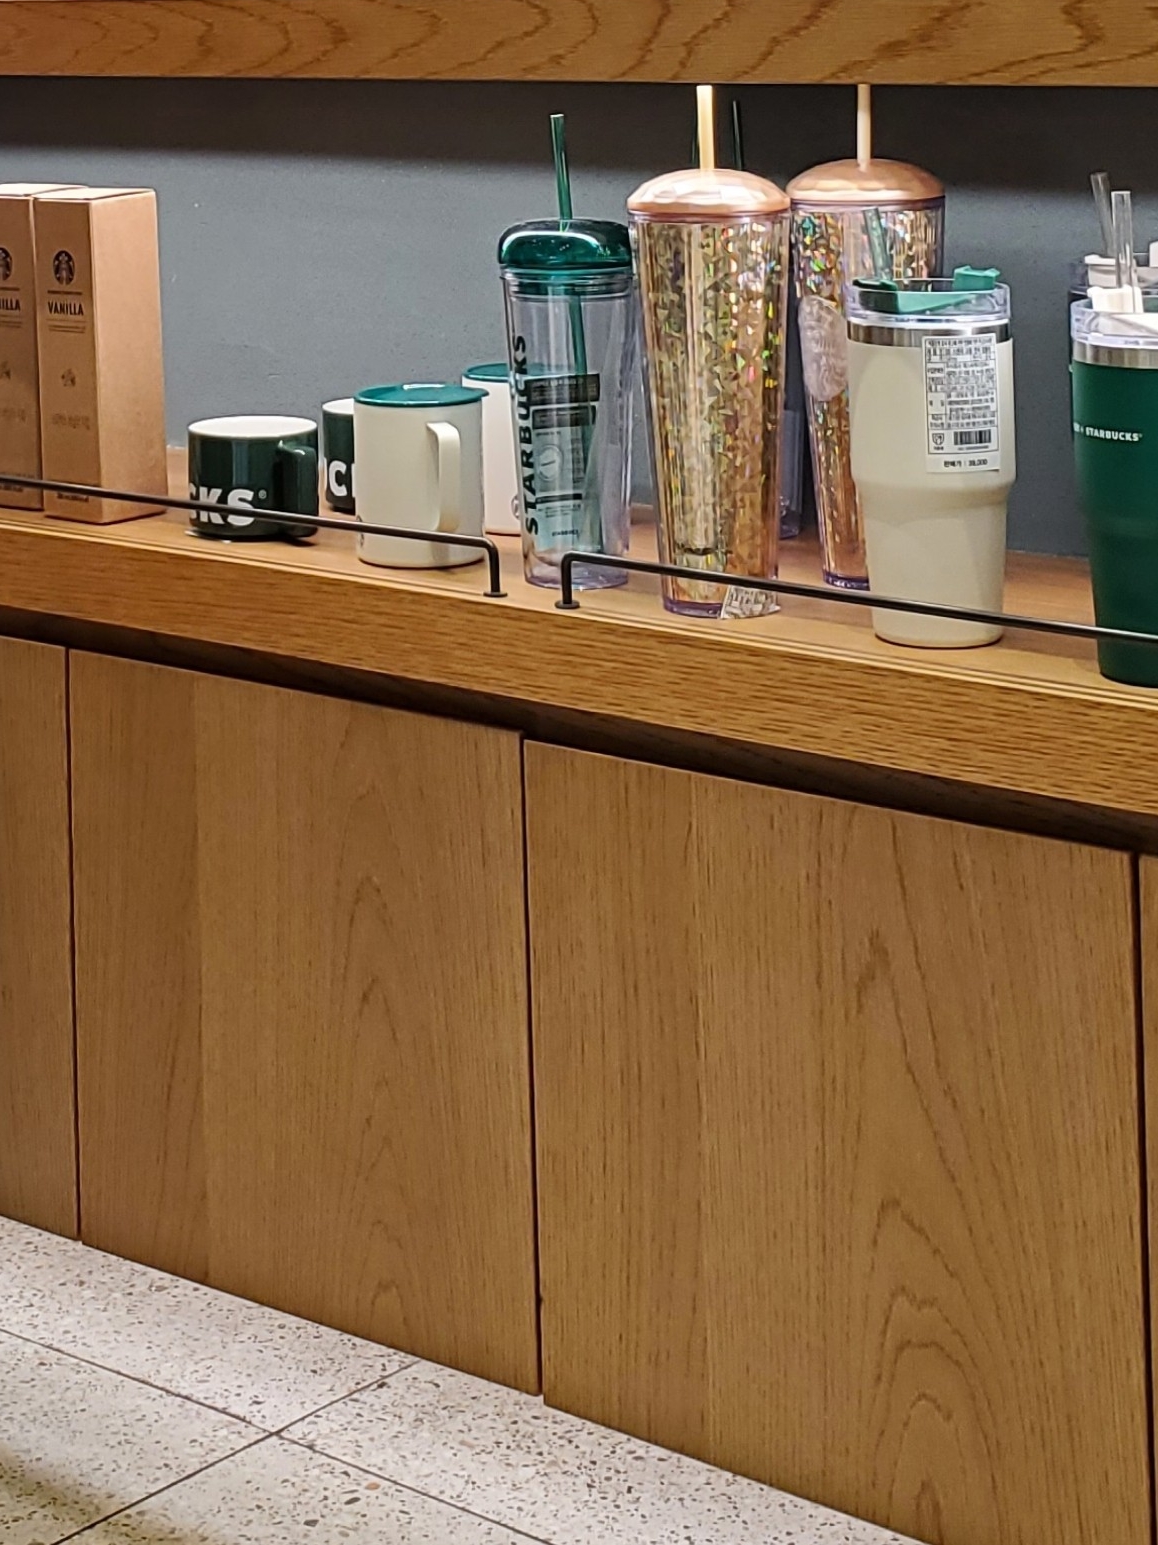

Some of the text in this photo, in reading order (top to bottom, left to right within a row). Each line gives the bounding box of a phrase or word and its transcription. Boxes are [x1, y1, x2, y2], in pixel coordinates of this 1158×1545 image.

[47, 301, 84, 316] VANILLA
[513, 335, 539, 535] STARBUCKS
[1085, 426, 1139, 442] STARBUCKS
[328, 459, 355, 498] C
[190, 482, 256, 527] KS
